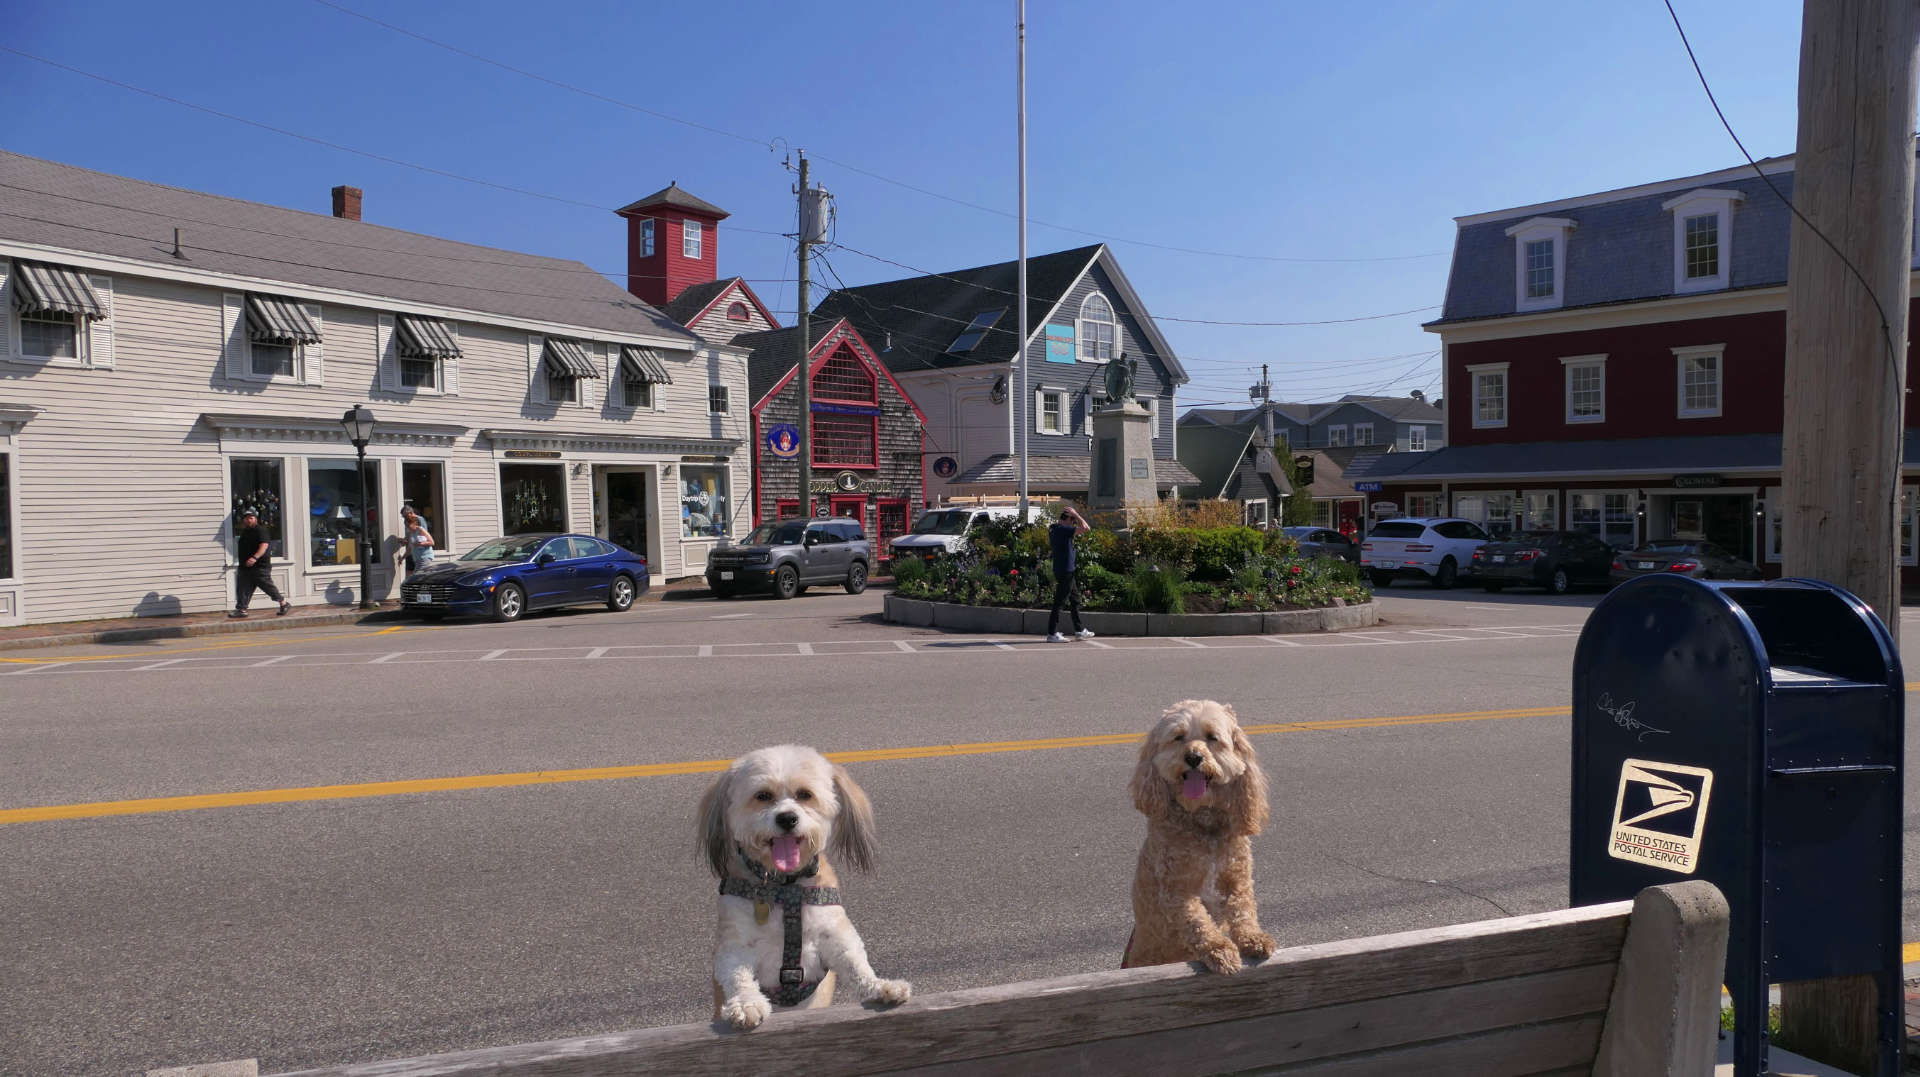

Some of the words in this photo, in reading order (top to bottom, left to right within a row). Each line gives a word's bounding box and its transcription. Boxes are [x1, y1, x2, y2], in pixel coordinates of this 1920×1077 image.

[1613, 842, 1648, 858] POSTAL
[1650, 850, 1689, 867] SERVICE
[1616, 831, 1651, 846] UNITED
[1653, 838, 1687, 854] STATES
